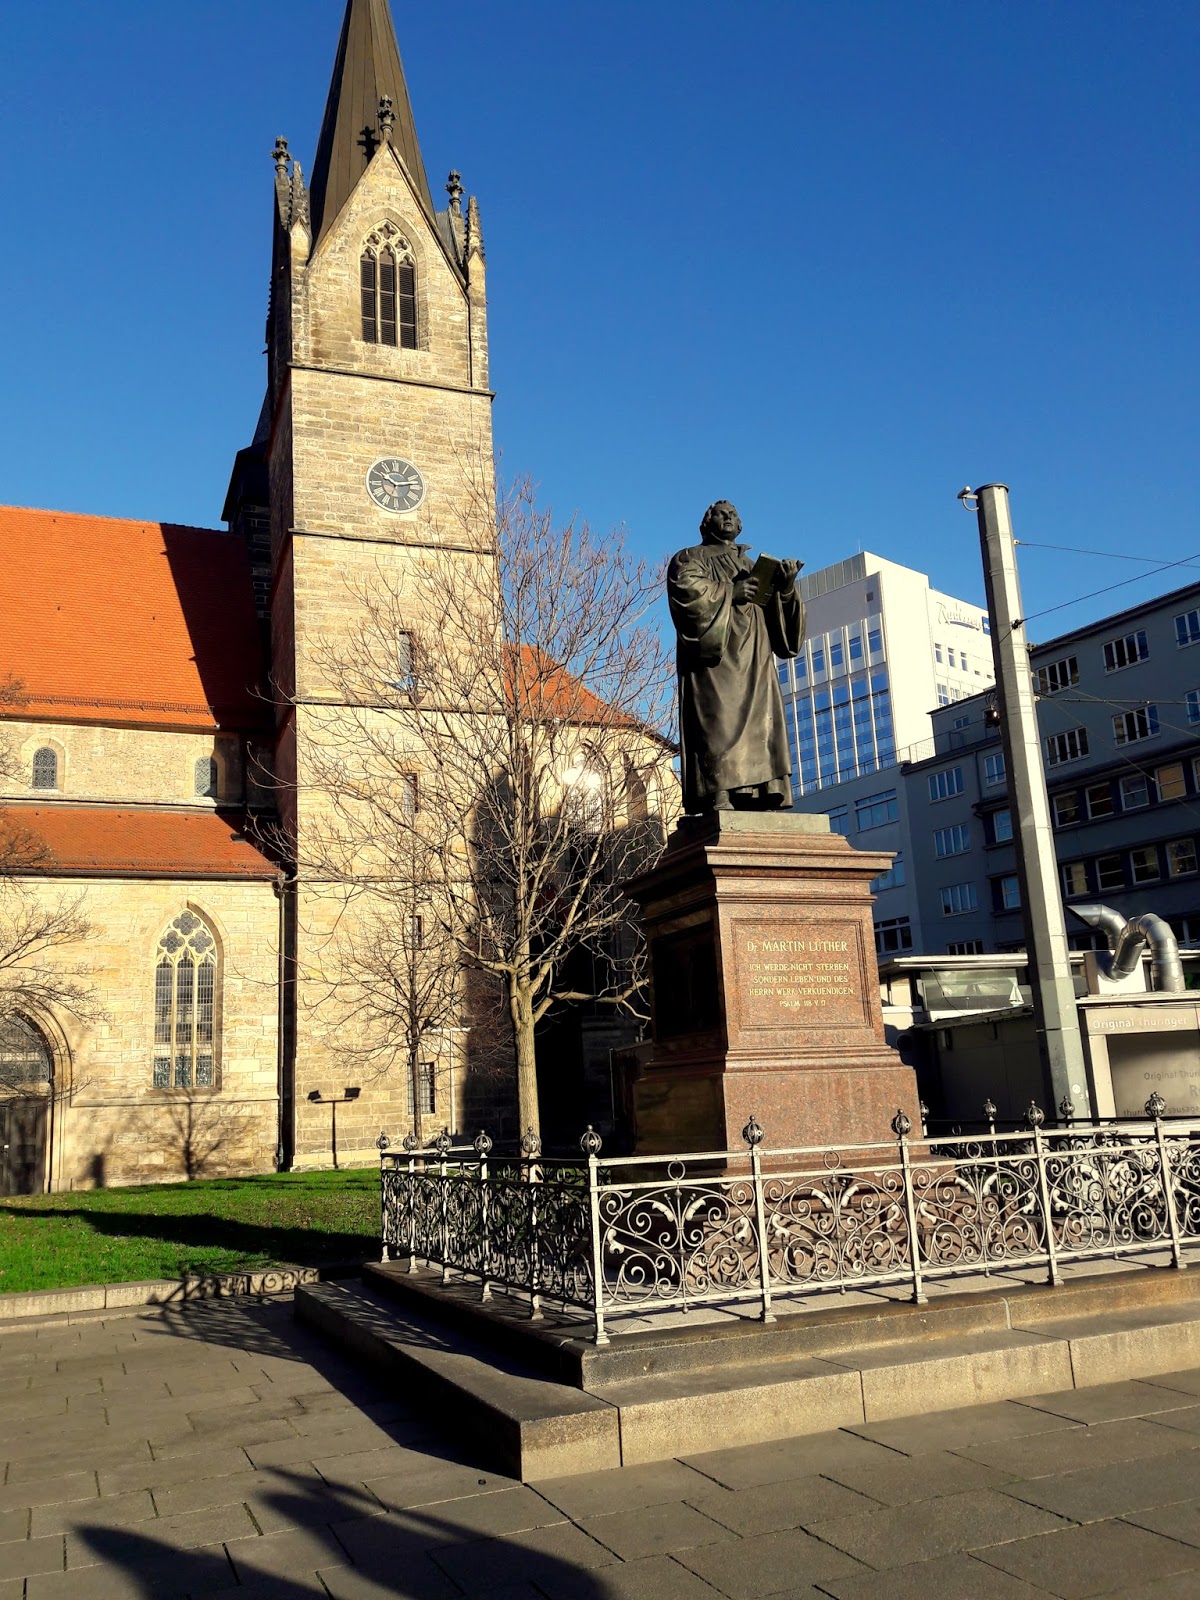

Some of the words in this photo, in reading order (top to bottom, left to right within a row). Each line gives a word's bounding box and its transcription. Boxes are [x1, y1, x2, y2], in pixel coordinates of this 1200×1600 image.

[762, 941, 805, 952] MARTIN
[809, 941, 848, 952] LUTHER
[749, 963, 761, 971] ICH
[763, 963, 789, 971] WERDE
[790, 963, 812, 971] NICHT
[753, 975, 788, 984] SONDERN
[790, 975, 814, 983] LEBEN
[816, 975, 832, 983] UND
[834, 975, 848, 983] DES
[749, 988, 774, 996] HERRN
[776, 987, 795, 995] WERK
[1093, 1017, 1135, 1031] Original
[1143, 1071, 1177, 1081] Original
